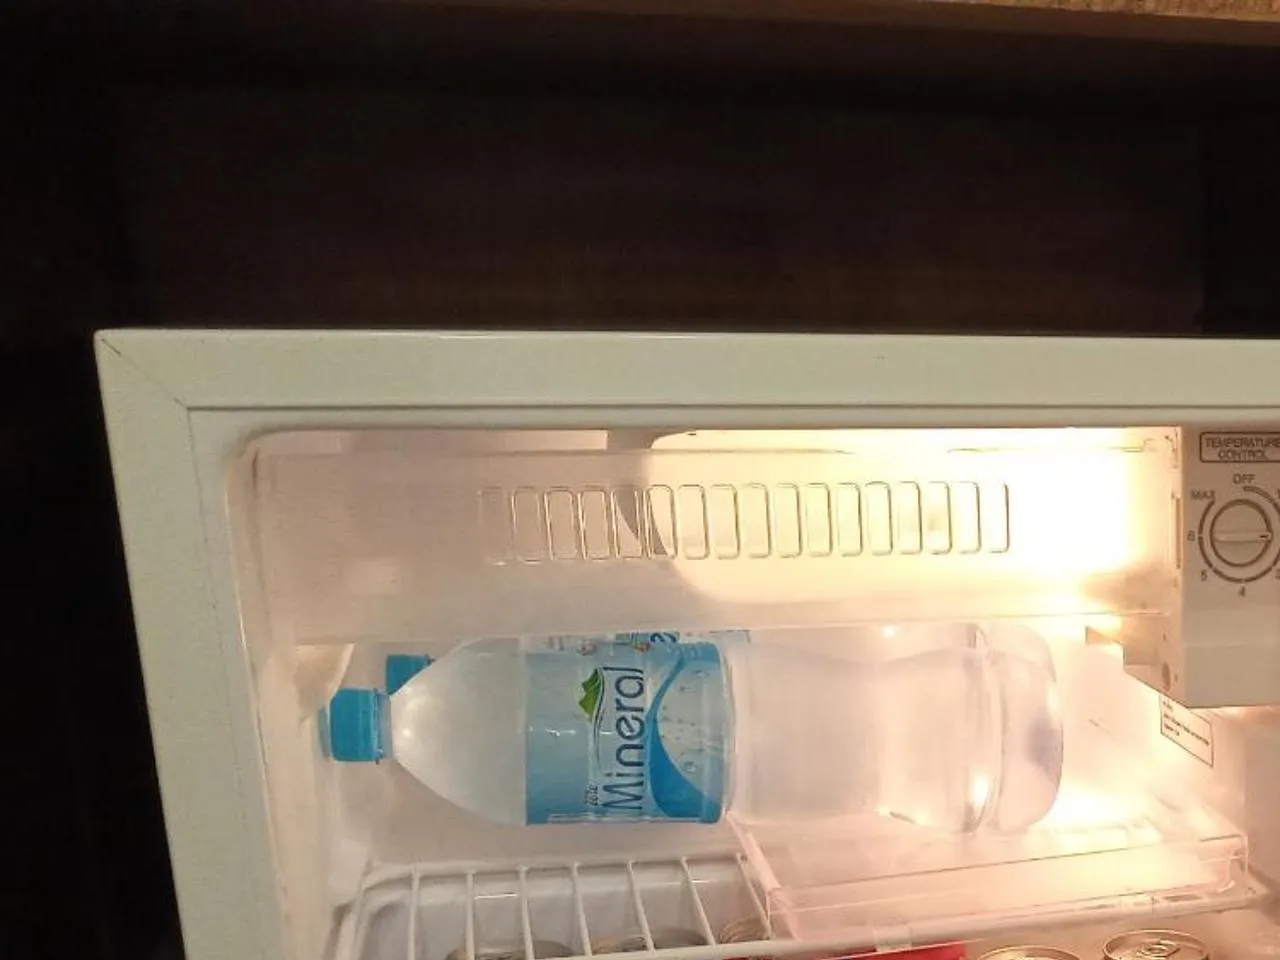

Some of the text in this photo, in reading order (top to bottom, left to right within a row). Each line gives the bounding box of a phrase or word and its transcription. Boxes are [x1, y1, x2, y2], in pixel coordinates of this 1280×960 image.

[1233, 474, 1256, 484] OFF
[1191, 490, 1216, 500] MAX
[601, 665, 645, 810] Mineral
